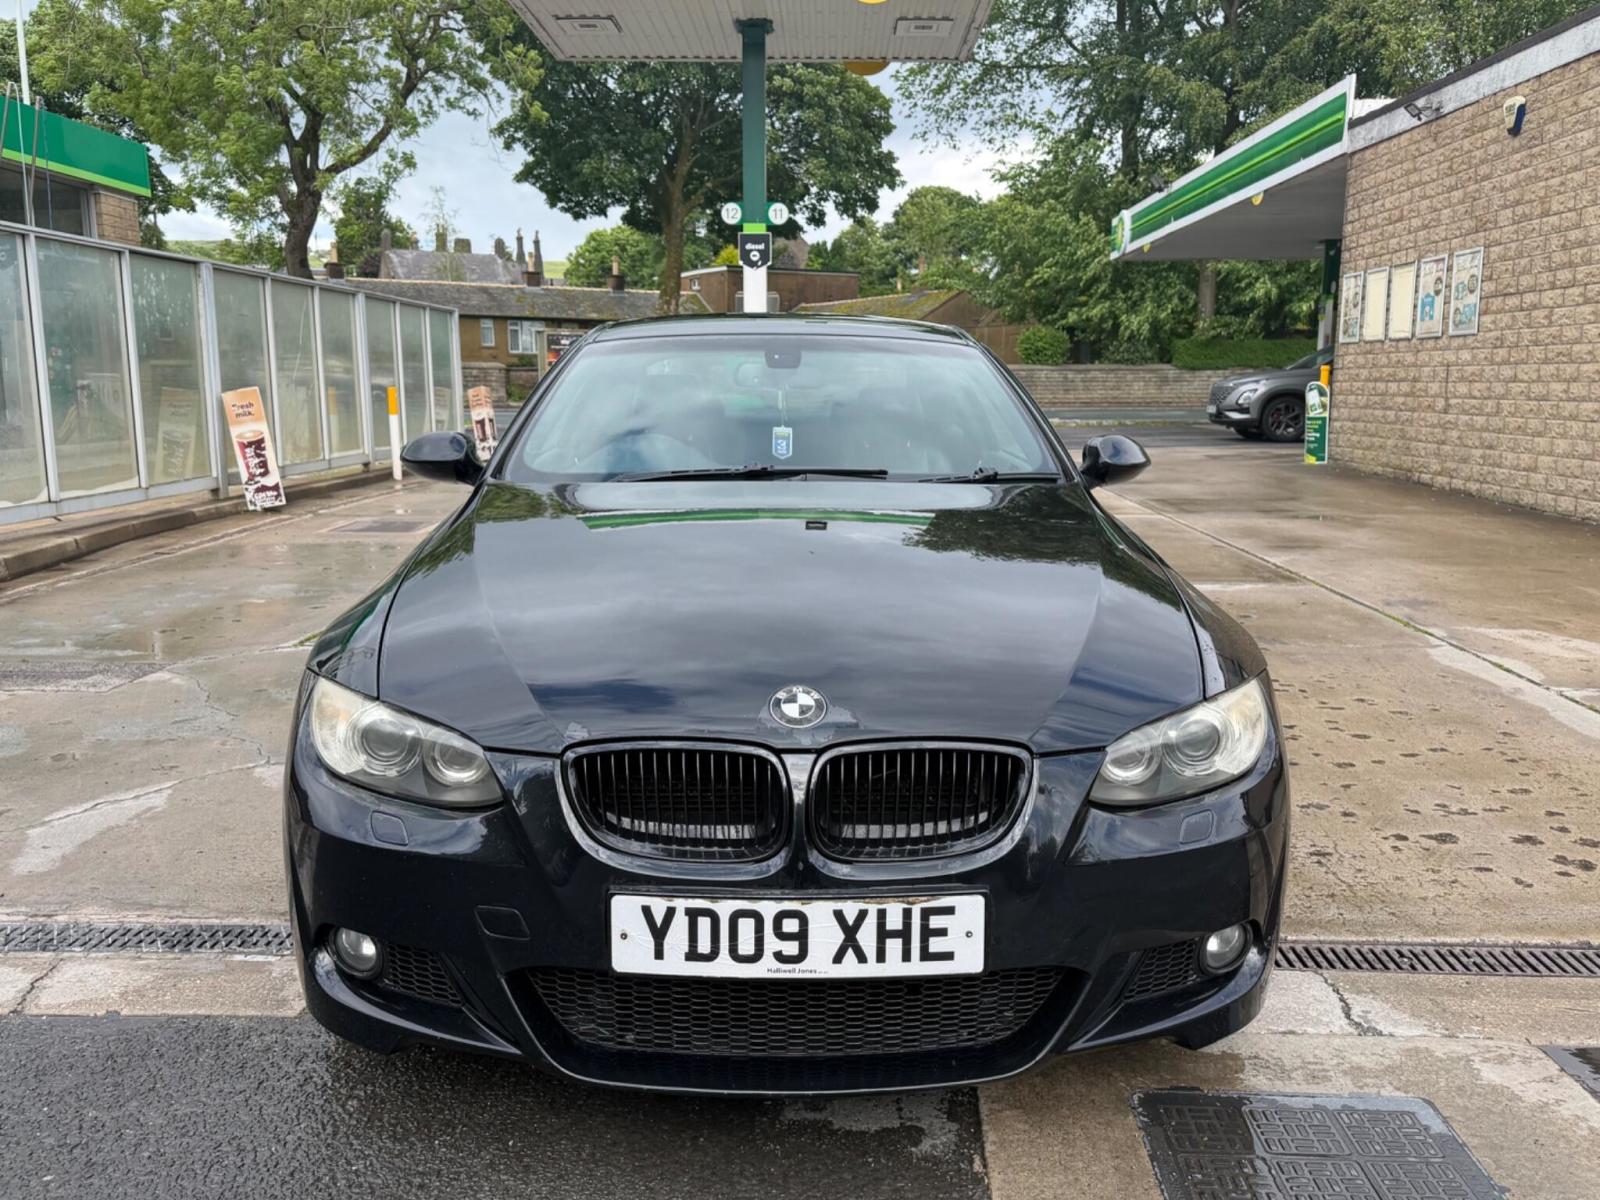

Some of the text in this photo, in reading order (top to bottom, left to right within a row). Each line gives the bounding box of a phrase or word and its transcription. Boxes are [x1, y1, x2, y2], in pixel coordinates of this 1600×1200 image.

[725, 207, 739, 220] 12
[772, 207, 784, 220] 11
[641, 905, 956, 964] YD09 XHE
